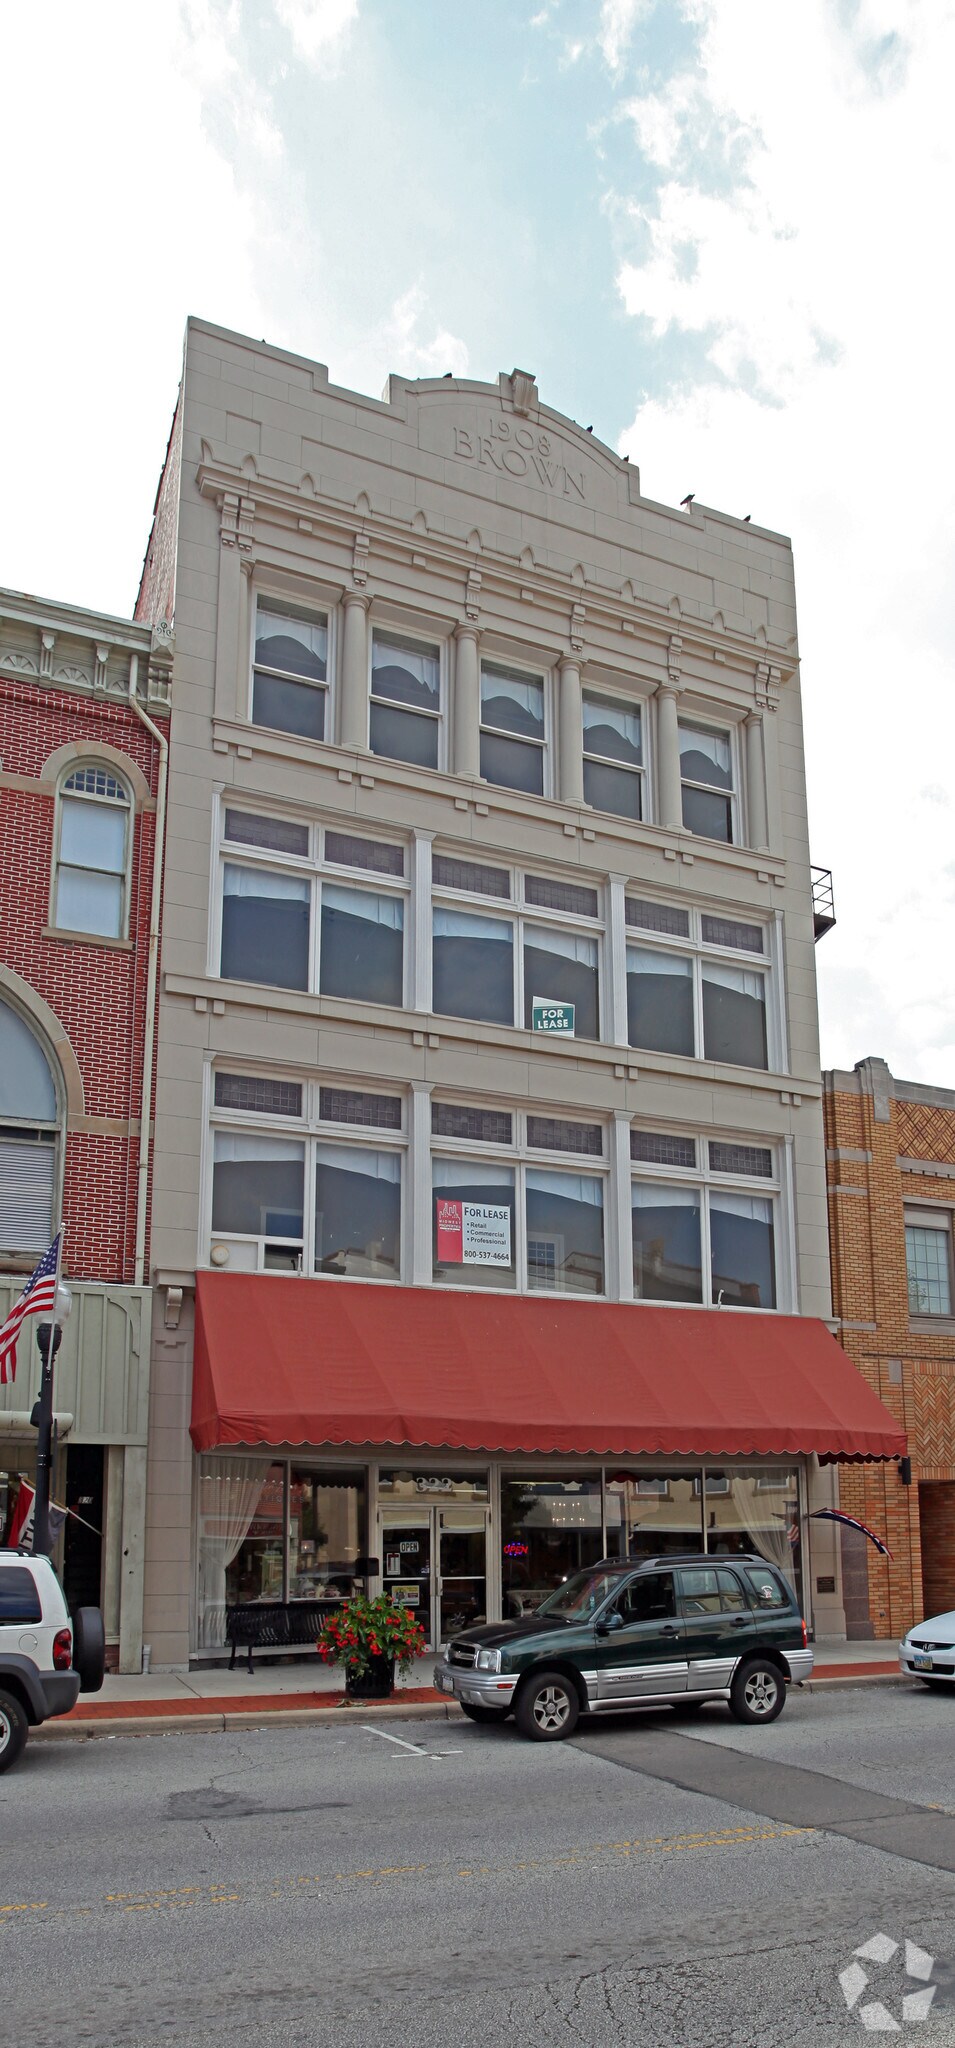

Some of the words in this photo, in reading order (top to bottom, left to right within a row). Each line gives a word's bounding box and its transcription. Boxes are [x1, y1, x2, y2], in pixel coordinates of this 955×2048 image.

[489, 418, 551, 457] 1908
[453, 426, 586, 500] BROWN
[542, 1009, 564, 1019] FOR
[537, 1019, 569, 1029] LEASE
[464, 1206, 482, 1218] FOR
[483, 1208, 508, 1220] LEASE
[470, 1221, 487, 1229] Retail
[470, 1229, 504, 1238] Commercial
[470, 1237, 506, 1245] Professional
[401, 1543, 418, 1552] OPEN
[503, 1545, 529, 1555] OPEN
